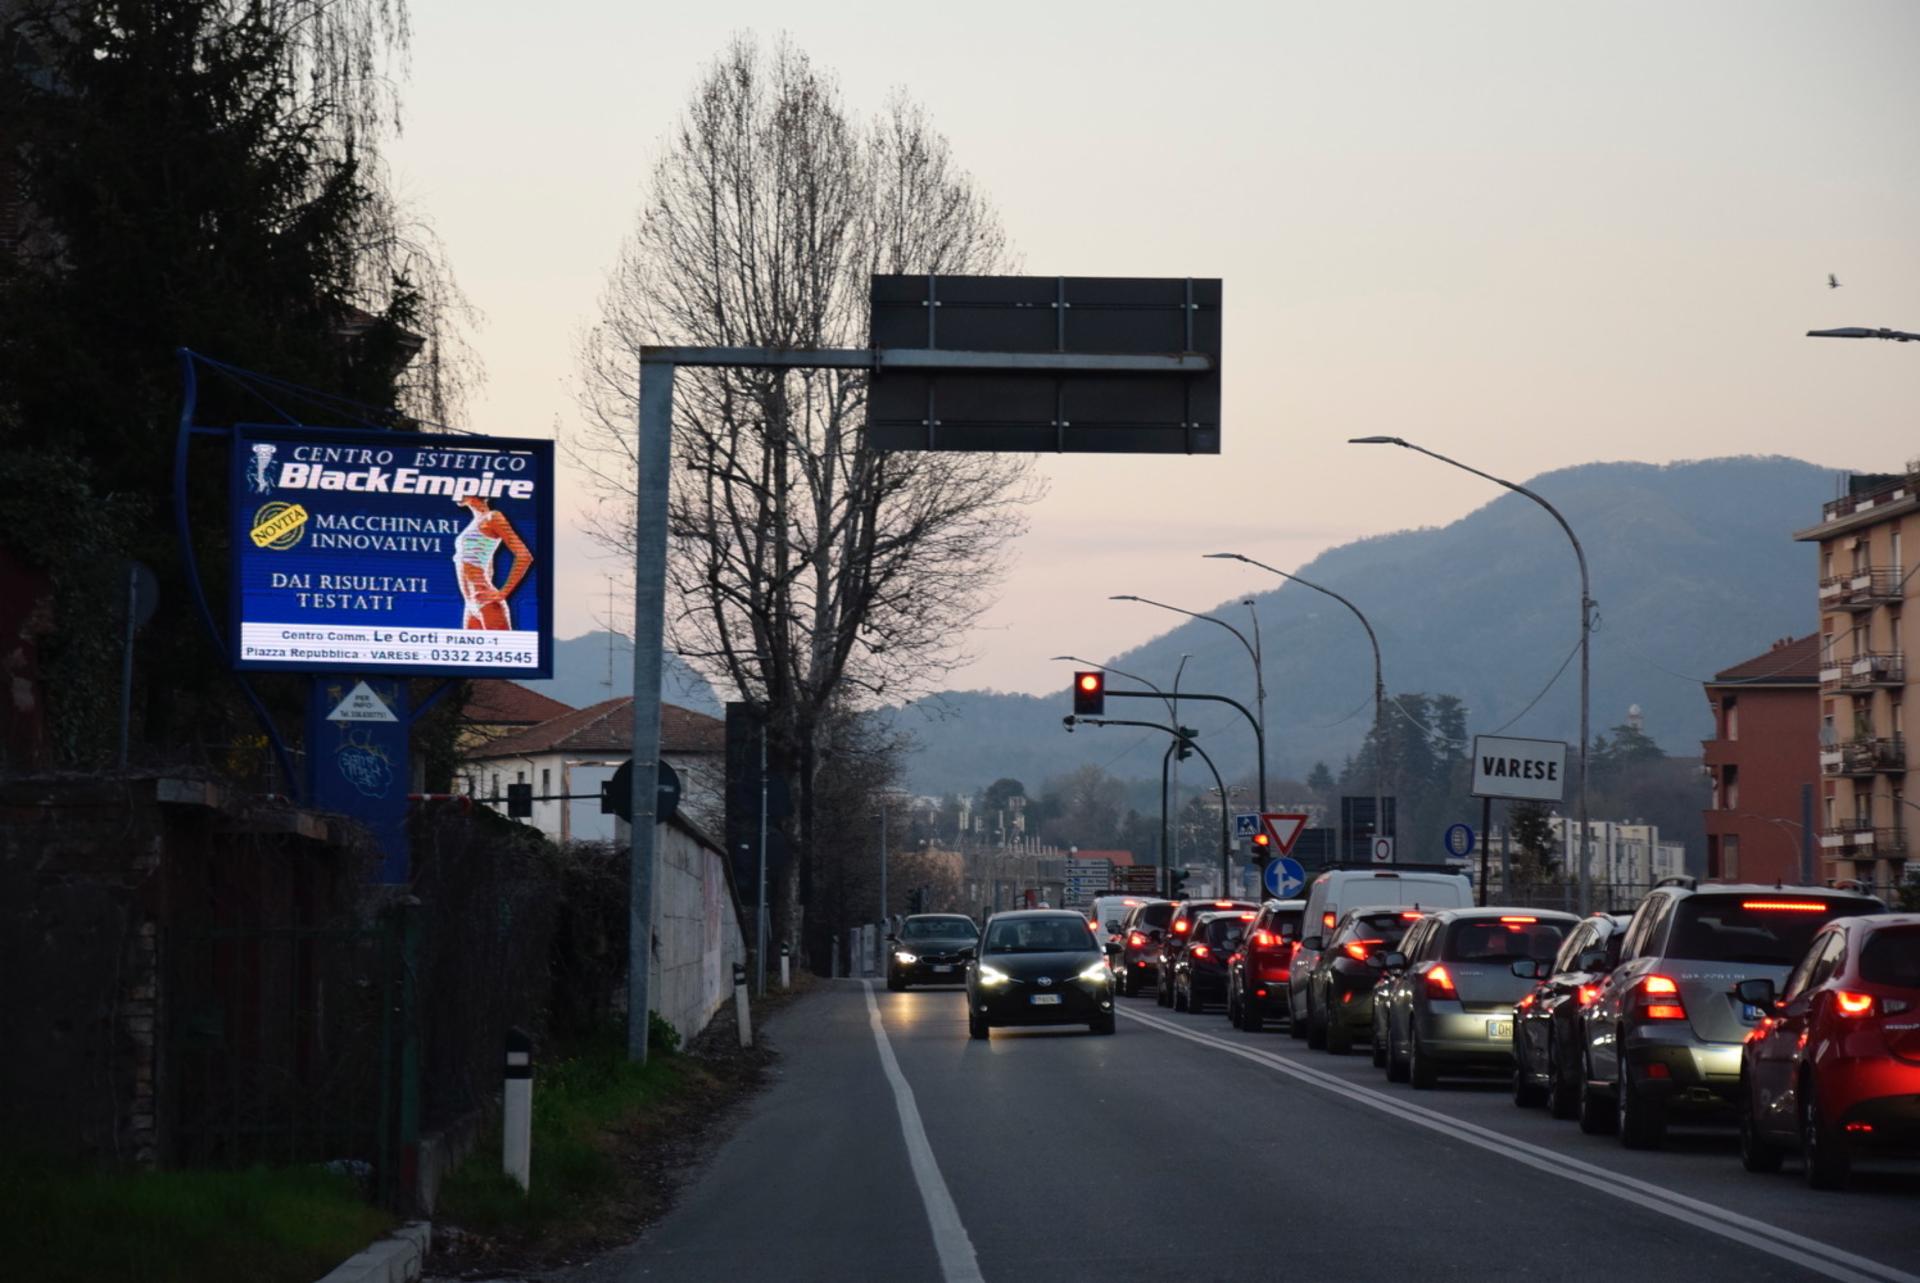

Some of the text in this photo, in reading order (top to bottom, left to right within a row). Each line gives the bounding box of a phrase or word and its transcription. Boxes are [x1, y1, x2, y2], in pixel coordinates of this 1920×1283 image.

[293, 446, 526, 472] CENTRO ESTETICO
[316, 514, 460, 534] MACCHINARI
[310, 533, 442, 552] INNOVATIVI
[271, 573, 428, 593] DAI RISULTATI
[296, 593, 394, 610] TESTATI
[282, 631, 324, 640] Centro
[327, 632, 370, 642] Comm.
[374, 630, 393, 642] Le
[398, 631, 438, 643] Corti
[446, 635, 485, 645] PIANO
[246, 647, 286, 657] Piazza
[290, 648, 359, 659] Repubblica
[371, 650, 420, 660] VARESE
[431, 649, 470, 662] 0332
[475, 650, 533, 664] 234545
[1482, 756, 1558, 781] VARESE
